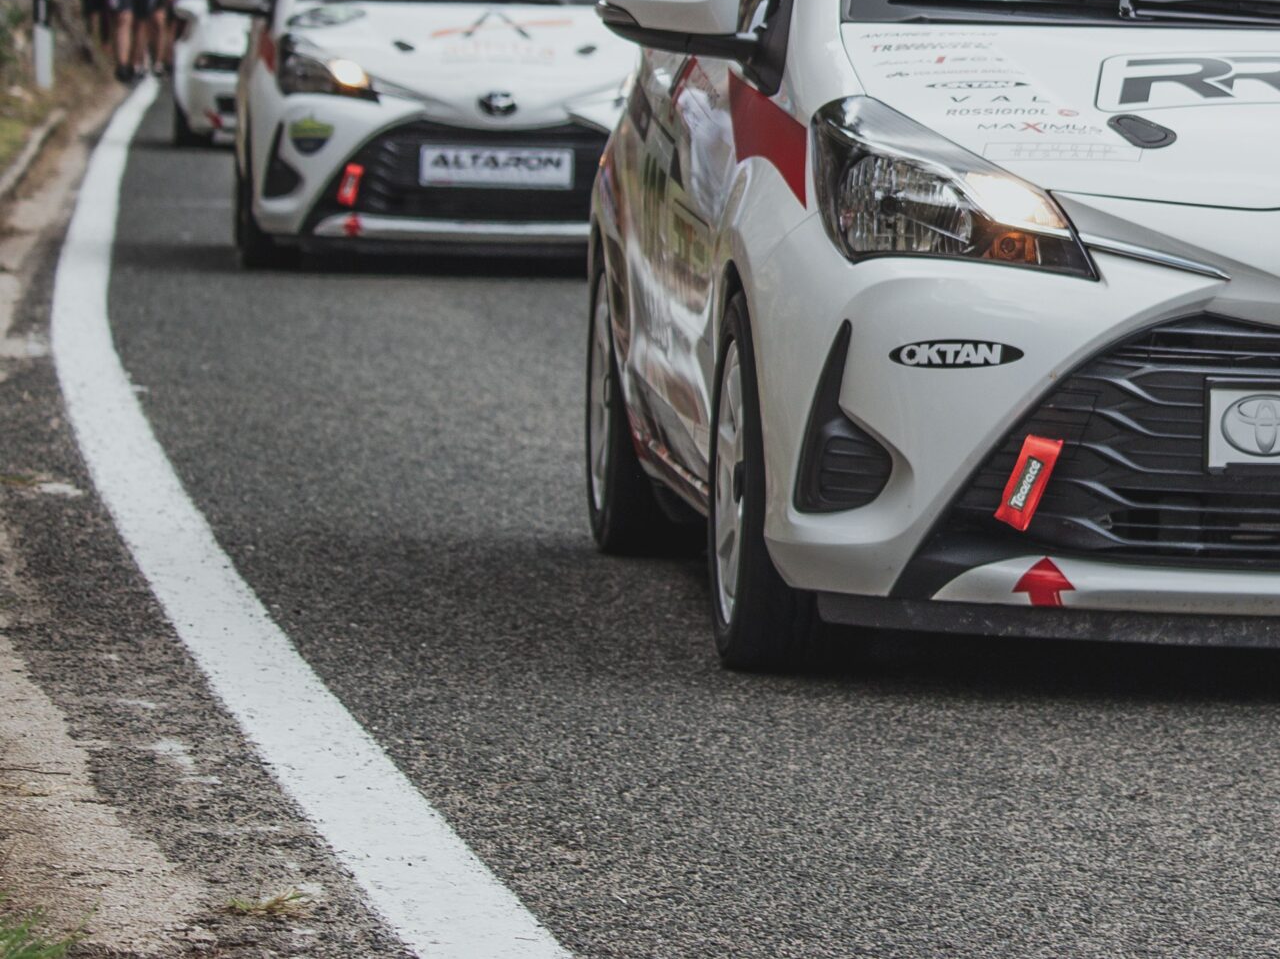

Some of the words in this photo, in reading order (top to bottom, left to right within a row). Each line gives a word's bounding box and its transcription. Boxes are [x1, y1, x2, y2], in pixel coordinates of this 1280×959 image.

[977, 122, 1103, 134] MAXIMUS
[432, 154, 562, 171] ALTARON
[900, 343, 1002, 365] OKTAN
